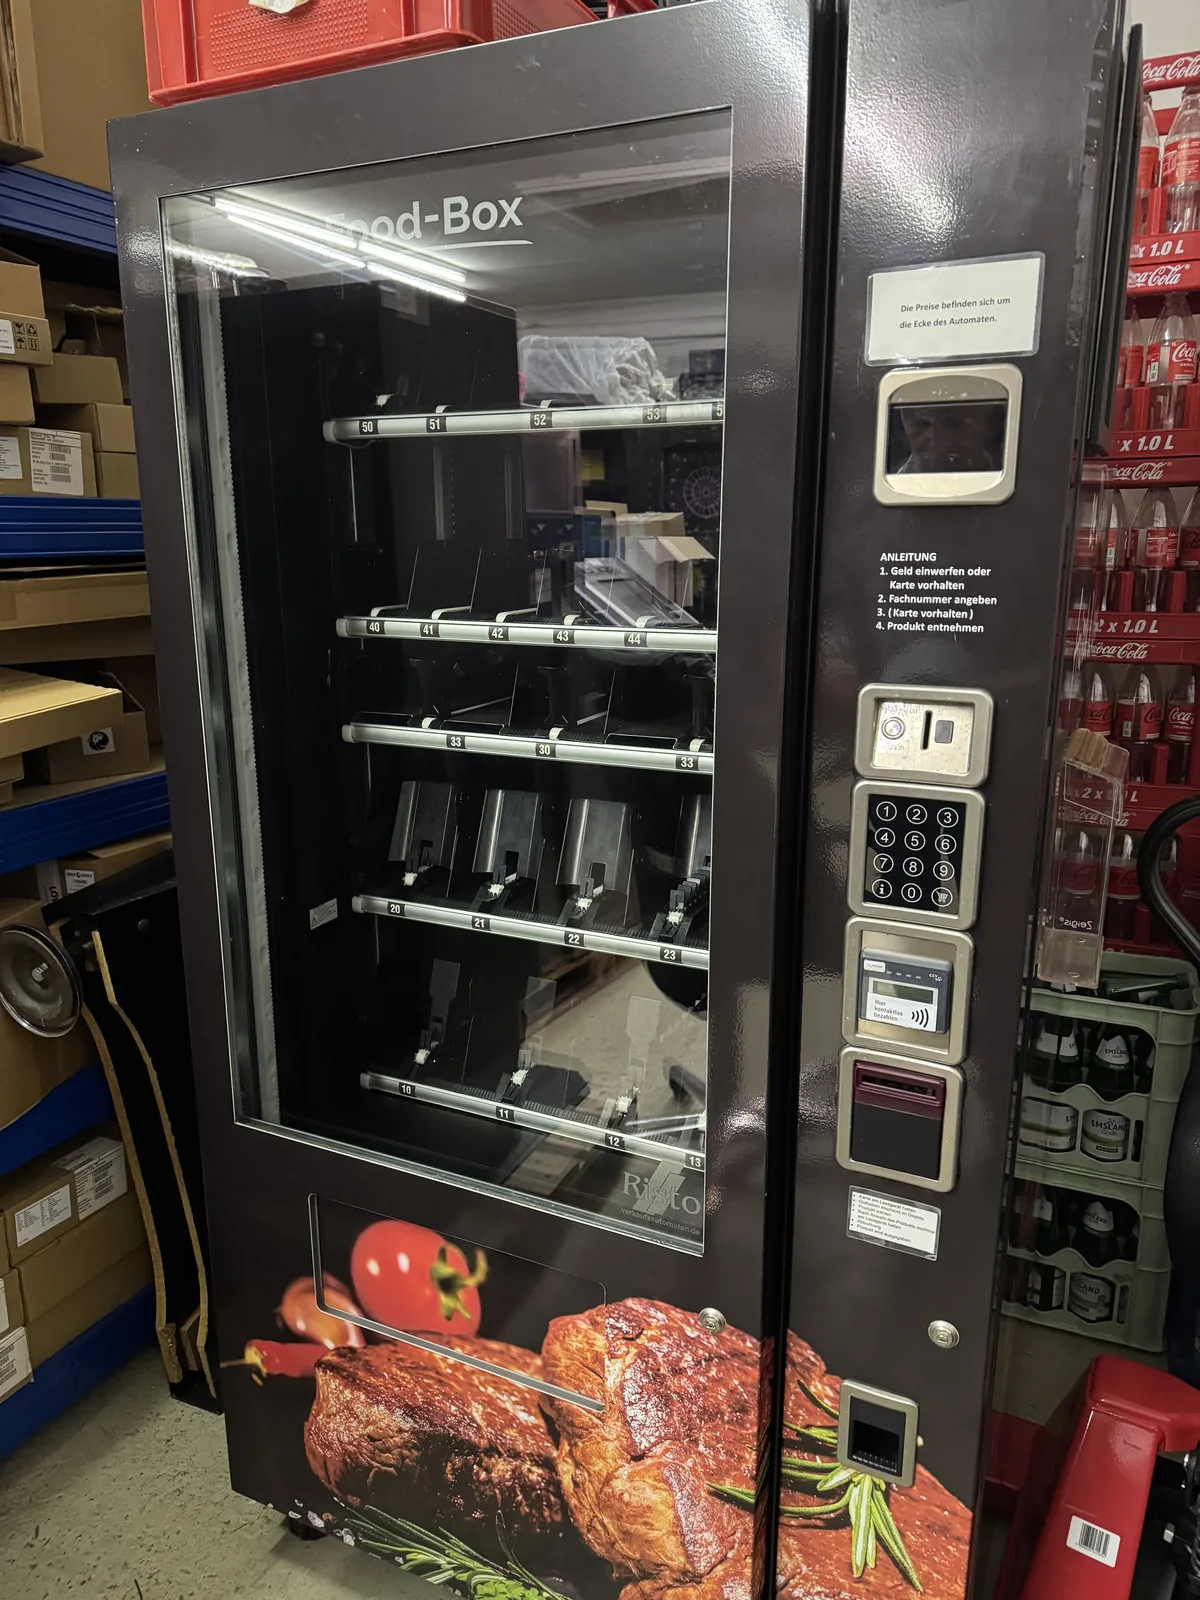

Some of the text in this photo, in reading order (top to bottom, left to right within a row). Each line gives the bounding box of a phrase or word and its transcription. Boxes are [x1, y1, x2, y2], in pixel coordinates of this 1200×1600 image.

[1143, 54, 1200, 80] oca-Cola
[326, 195, 524, 244] Food-Box
[1150, 240, 1173, 257] 1.0
[1174, 239, 1185, 255] L
[900, 297, 1011, 313] Die Preise befinden sich um
[899, 315, 998, 329] die Ecke des Automaten.
[362, 421, 374, 433] 50
[429, 418, 441, 430] 51
[533, 414, 547, 426] 52
[646, 407, 661, 421] 53
[1119, 434, 1175, 452] x 1.0 L
[879, 552, 938, 562] ANLEITUNG
[879, 565, 992, 577] 1. Geld einwerfen oder
[889, 580, 965, 590] Karte vorhalten
[877, 593, 998, 606] 2. Fachnummer angeben
[876, 607, 886, 617] 3.
[368, 621, 641, 645] 40 41 42 43 44
[875, 621, 985, 633] 4. Produkt entnehmen
[1106, 622, 1119, 633] x
[1123, 620, 1147, 633] 1.0
[1148, 619, 1159, 634] L
[450, 736, 694, 769] 33 30 33
[883, 805, 952, 824] 1 2 3
[880, 831, 950, 850] 4 5 6
[879, 857, 948, 877] 7 8 9
[907, 887, 916, 899] 0
[389, 904, 676, 961] 20 21 22 23
[874, 999, 887, 1007] Hier
[874, 1006, 903, 1016] kontaktlos
[873, 1012, 898, 1021] bezahlen
[401, 1084, 701, 1168] 10 11 12 13
[622, 1171, 701, 1215] Risto
[858, 1204, 876, 1213] Produkt
[858, 1199, 880, 1209] Guthaben
[907, 1212, 924, 1221] Display
[621, 1207, 701, 1236] verkaufsautomaten.de
[856, 1223, 874, 1233] Produkt
